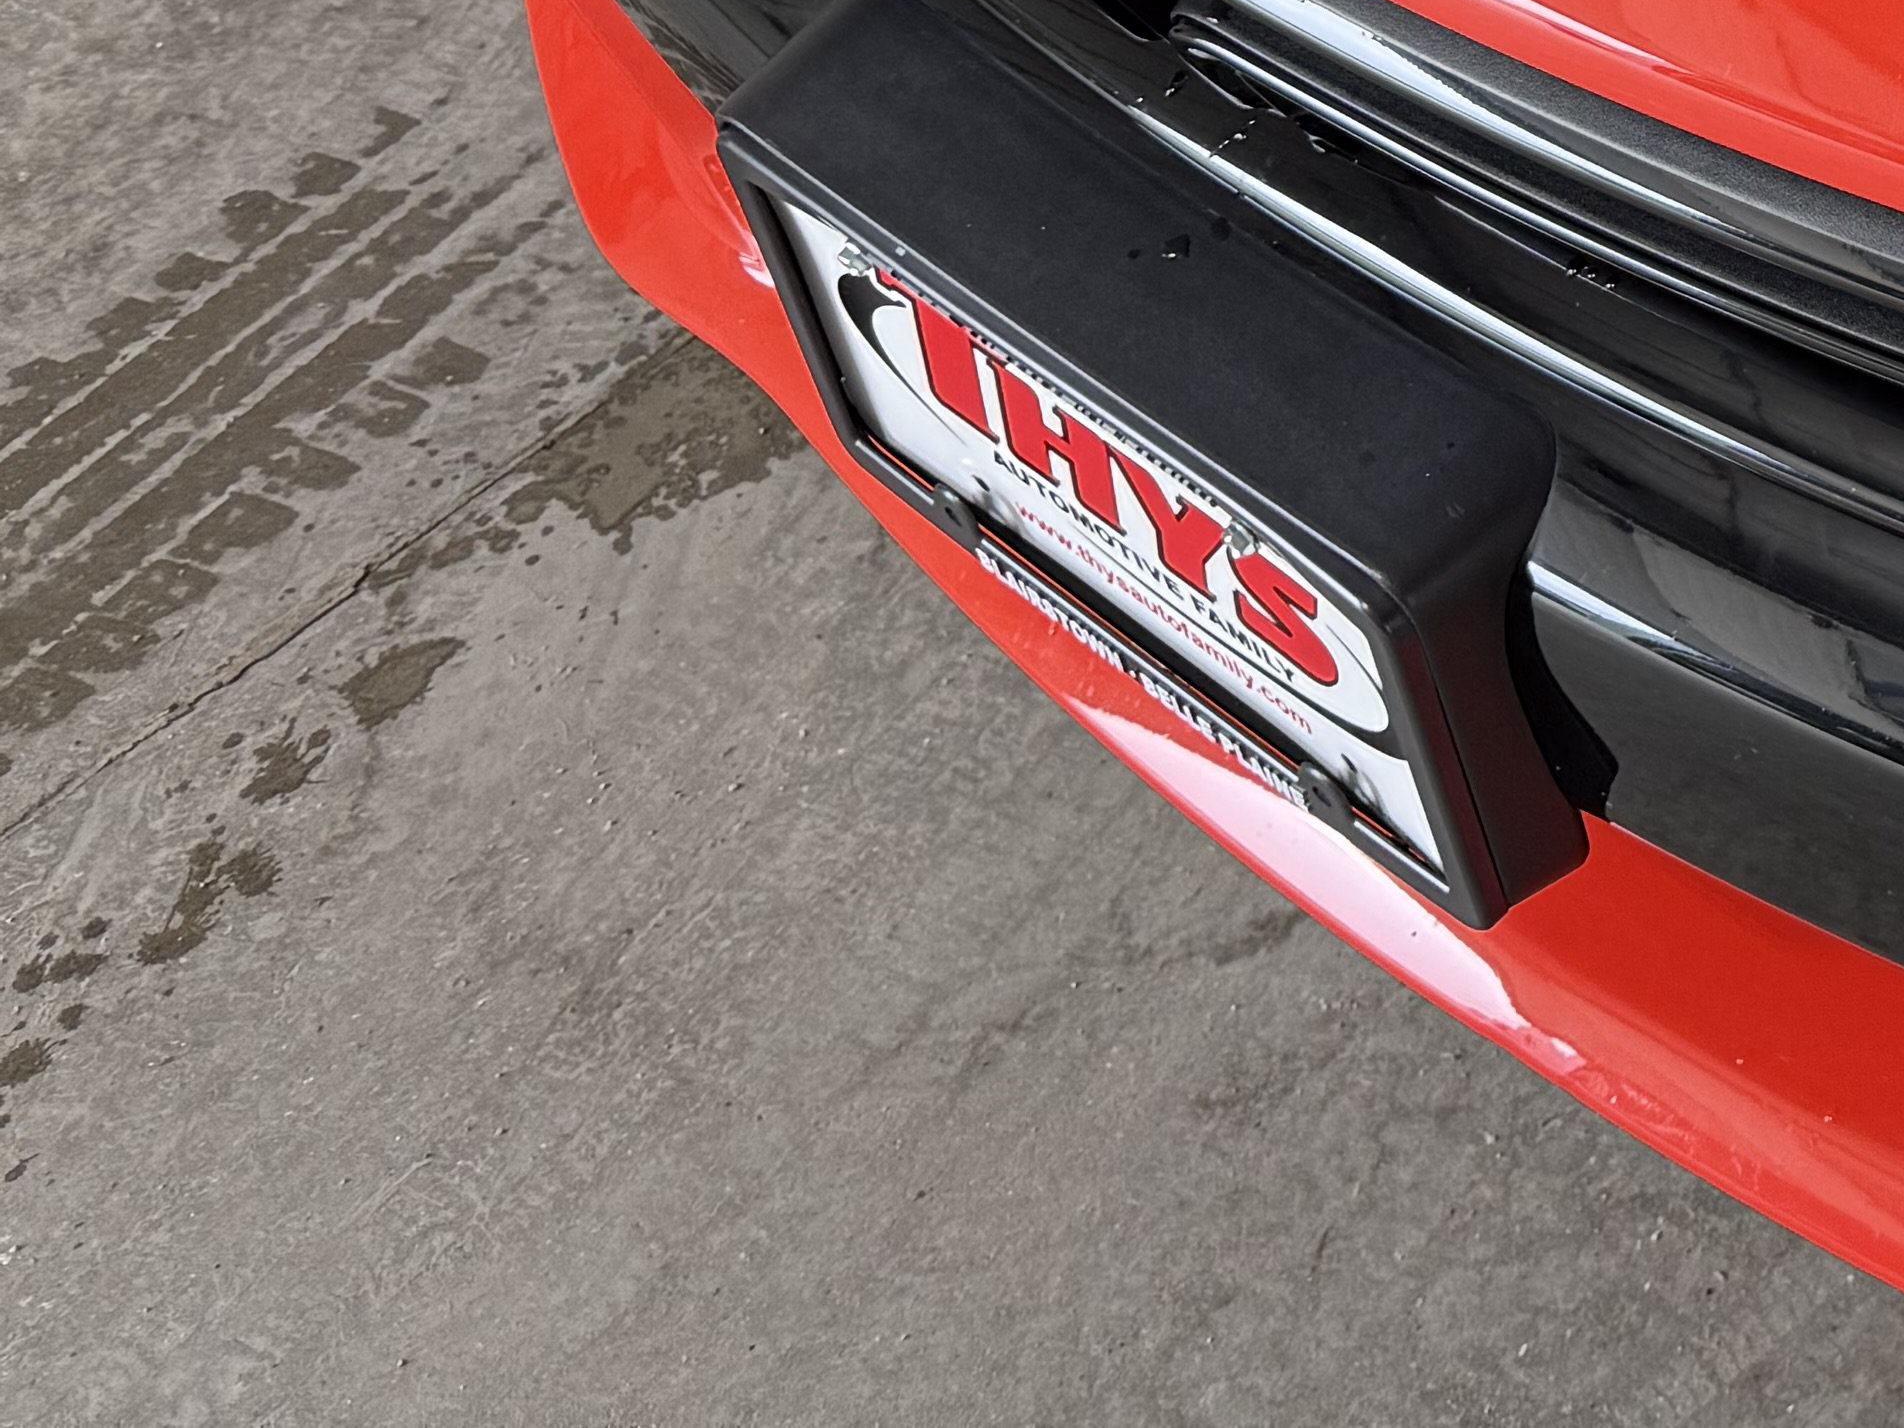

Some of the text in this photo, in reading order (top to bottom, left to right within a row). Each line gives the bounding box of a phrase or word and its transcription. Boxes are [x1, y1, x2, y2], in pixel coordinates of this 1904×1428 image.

[873, 268, 1339, 686] THYS
[993, 449, 1296, 683] AUTOMOTIVE FAMILY
[1015, 499, 1313, 735] www.thysautofamily.com
[1139, 671, 1217, 745] BELLE
